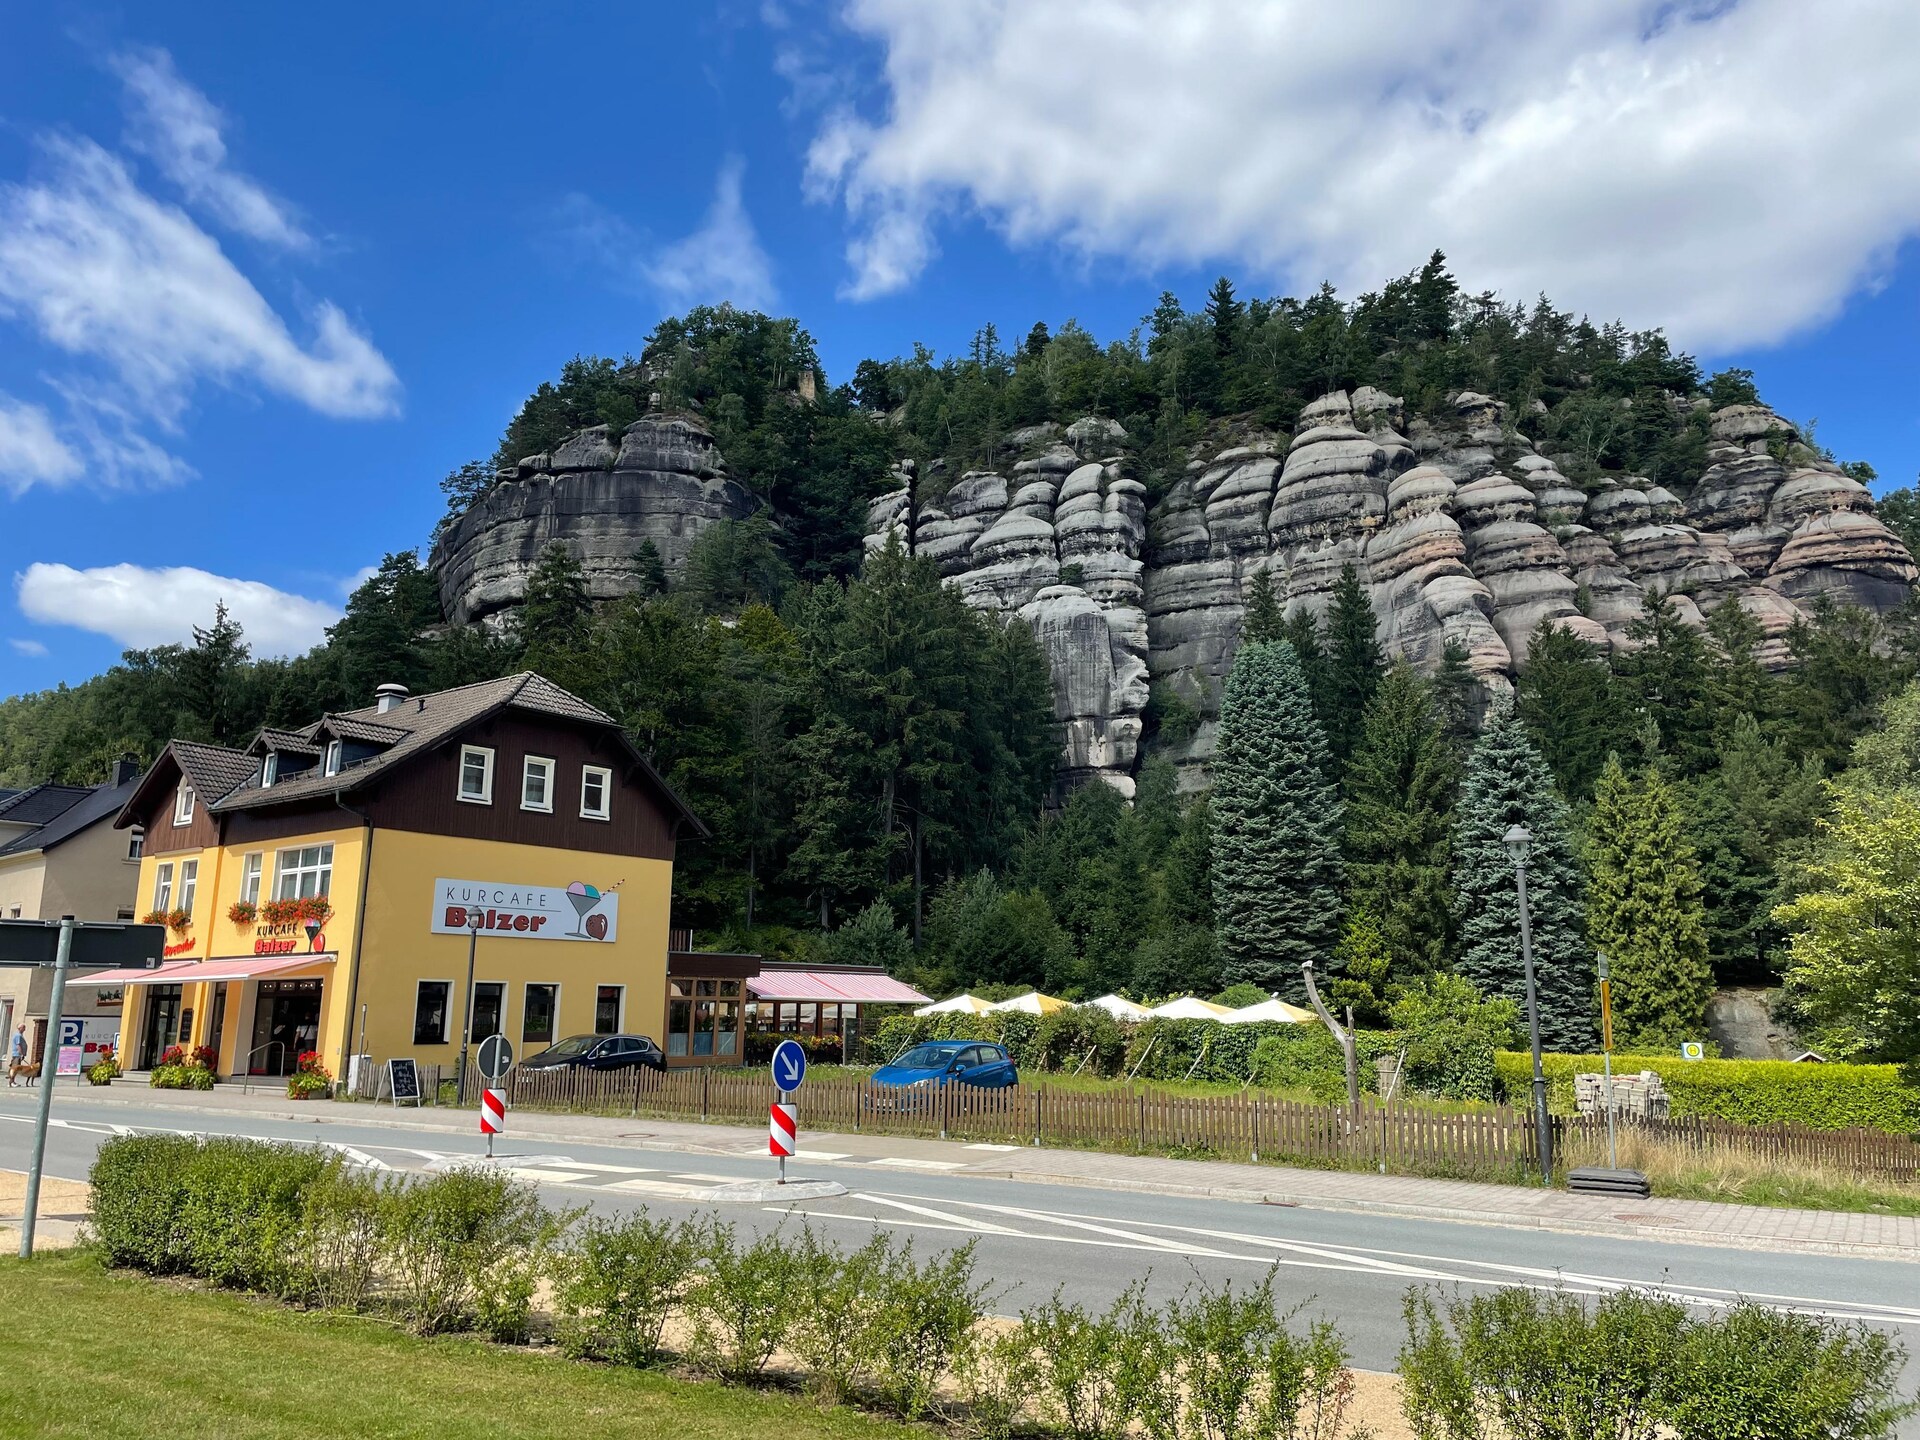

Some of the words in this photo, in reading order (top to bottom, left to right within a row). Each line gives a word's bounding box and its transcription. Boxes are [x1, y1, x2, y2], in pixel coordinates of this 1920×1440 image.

[446, 887, 547, 907] KURCAFE
[256, 922, 298, 938] KURCAFE
[254, 939, 297, 953] Balzer
[59, 1022, 79, 1044] P
